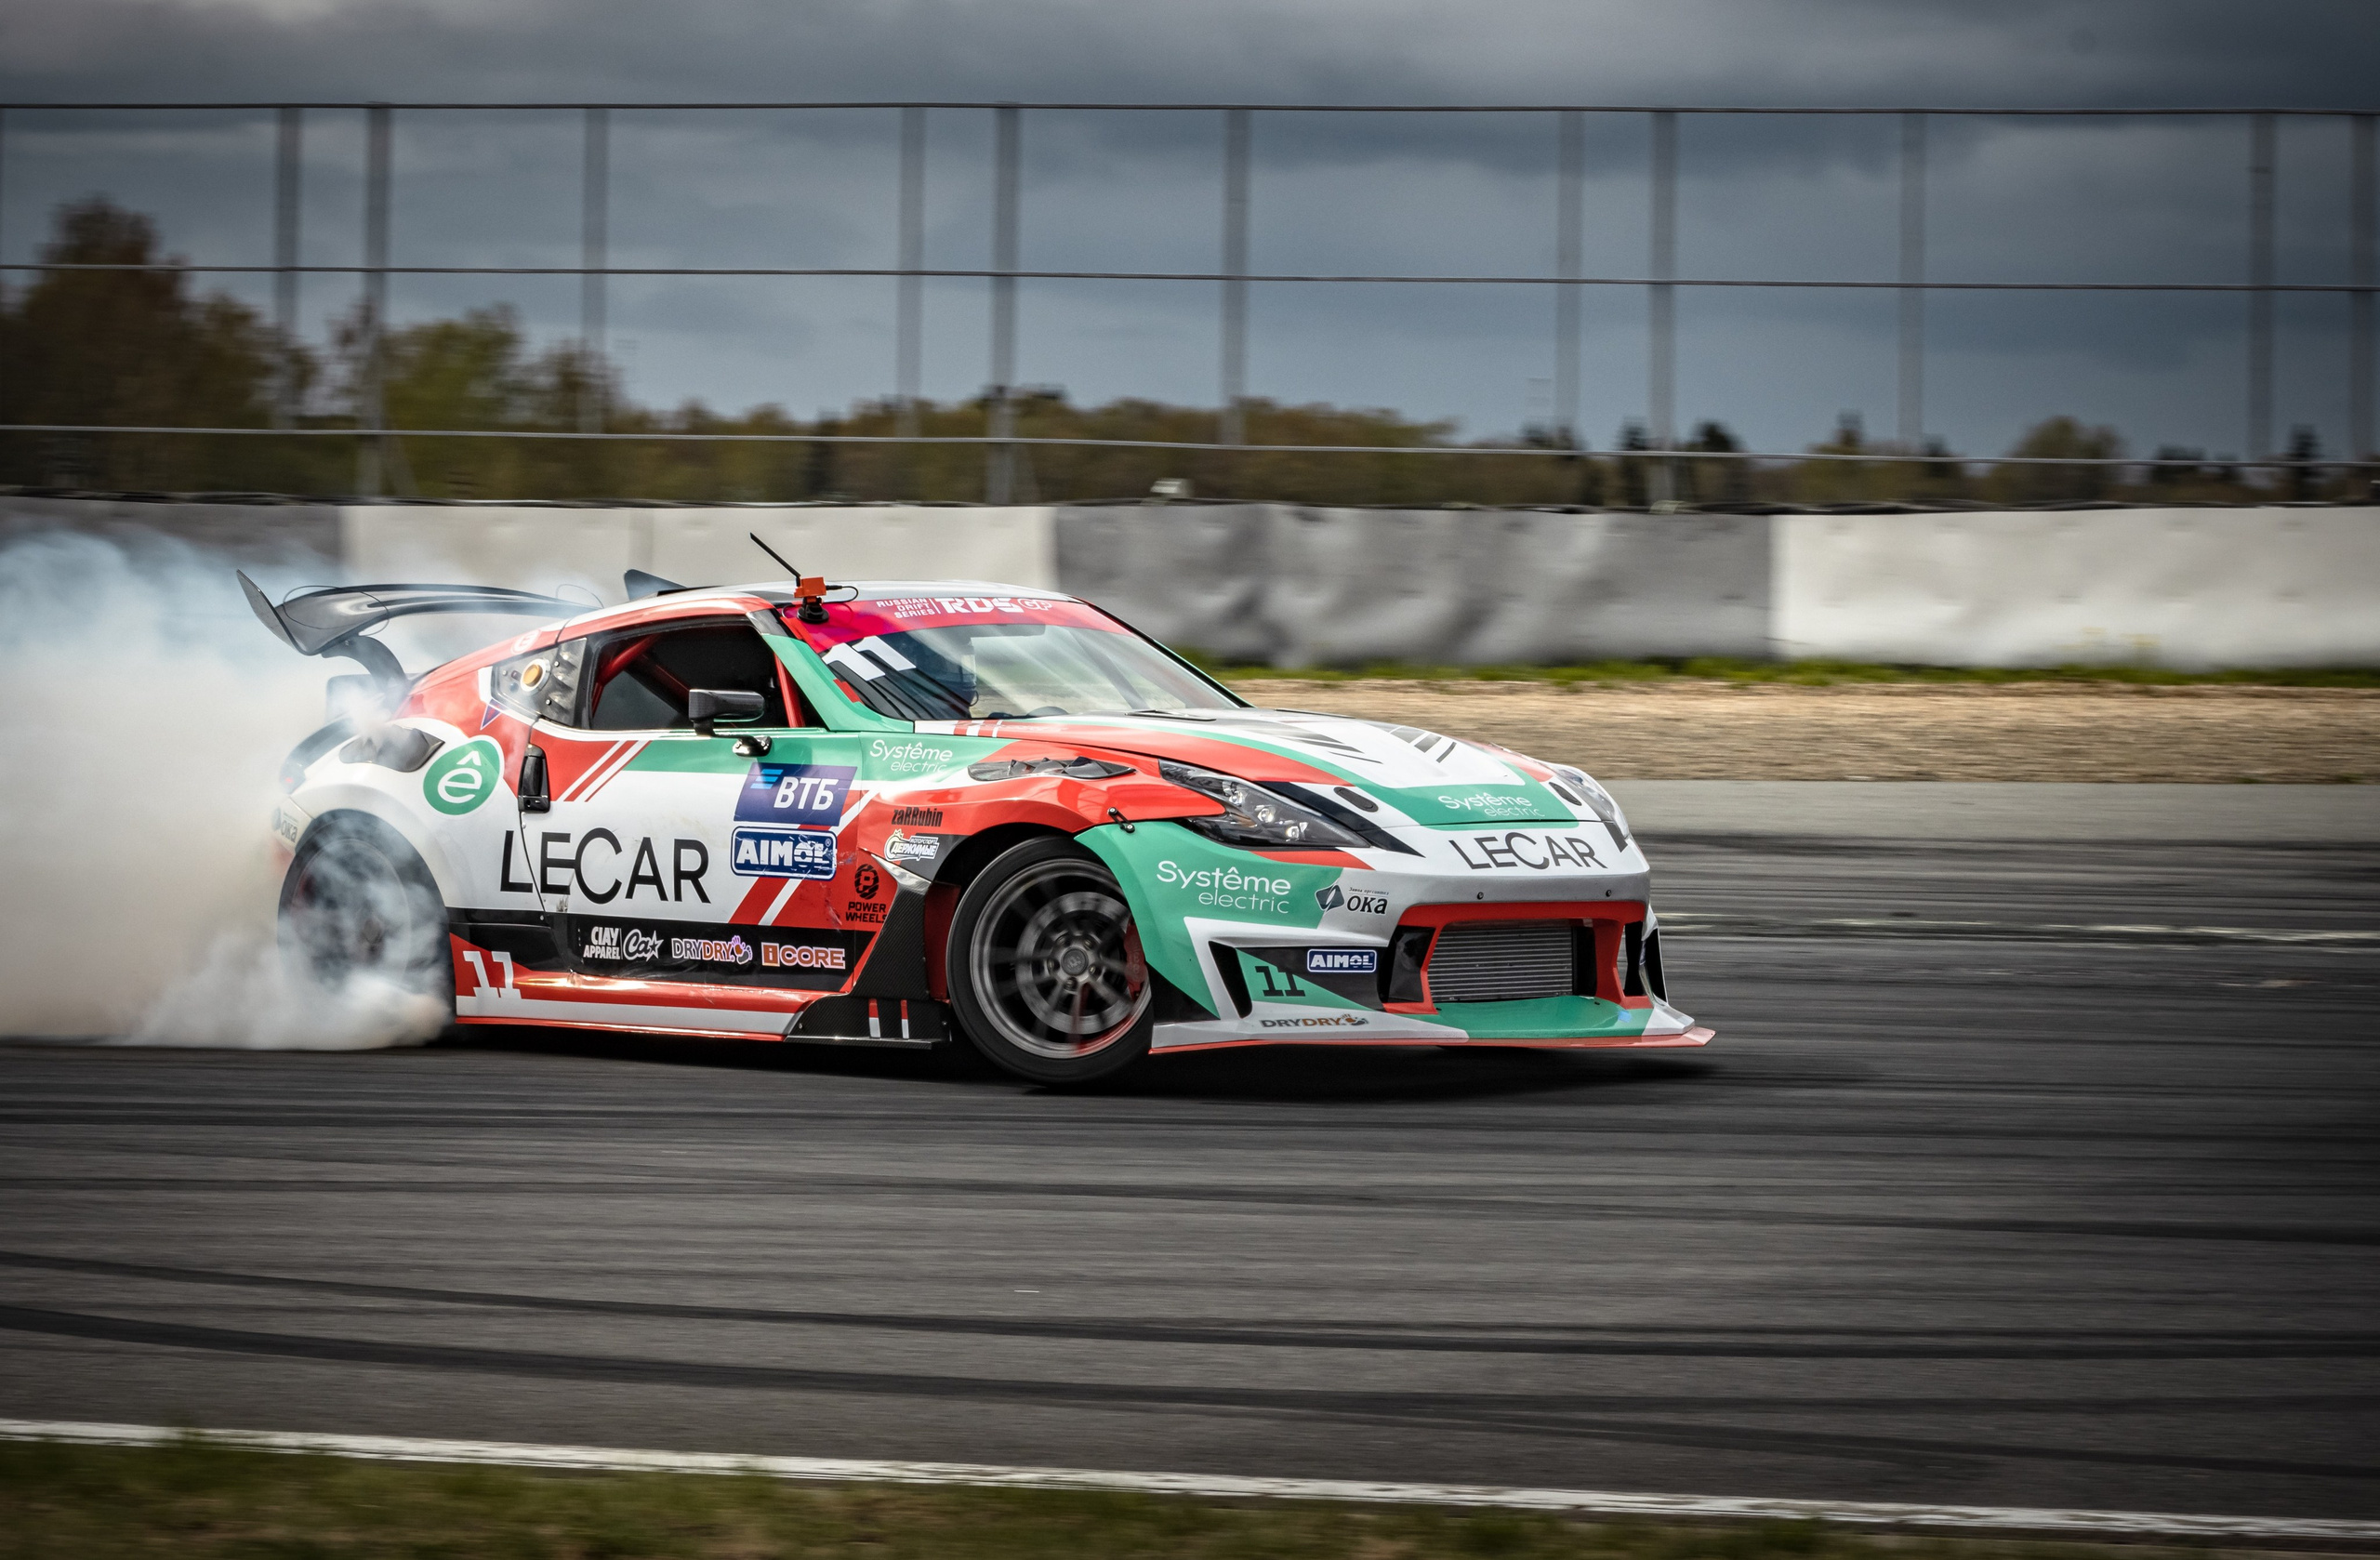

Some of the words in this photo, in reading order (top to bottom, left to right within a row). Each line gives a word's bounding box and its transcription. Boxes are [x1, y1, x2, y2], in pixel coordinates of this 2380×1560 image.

[876, 597, 928, 608] RUSSIAN
[897, 603, 931, 612] DRIFT
[934, 597, 1025, 614] RDS
[1016, 598, 1053, 612] GP
[893, 608, 936, 619] SERIES
[821, 634, 918, 681] 11
[869, 739, 954, 761] Systême
[890, 759, 947, 773] electric
[773, 775, 840, 811] ВТБ
[1437, 791, 1533, 811] Systême
[891, 806, 944, 827] zaRRubin
[1483, 805, 1546, 818] electric
[735, 838, 831, 868] AIMOL
[1448, 831, 1609, 870] LECAR
[499, 826, 712, 905] LECAR
[1156, 860, 1291, 895] Systême
[848, 901, 887, 913] POWER
[1198, 889, 1290, 914] electric
[845, 912, 888, 924] WHEELS
[590, 926, 620, 946] CLAY
[583, 945, 621, 960] APPAREL
[1310, 954, 1373, 969] AIMOL
[462, 950, 522, 1000] 11
[1254, 965, 1306, 998] 11
